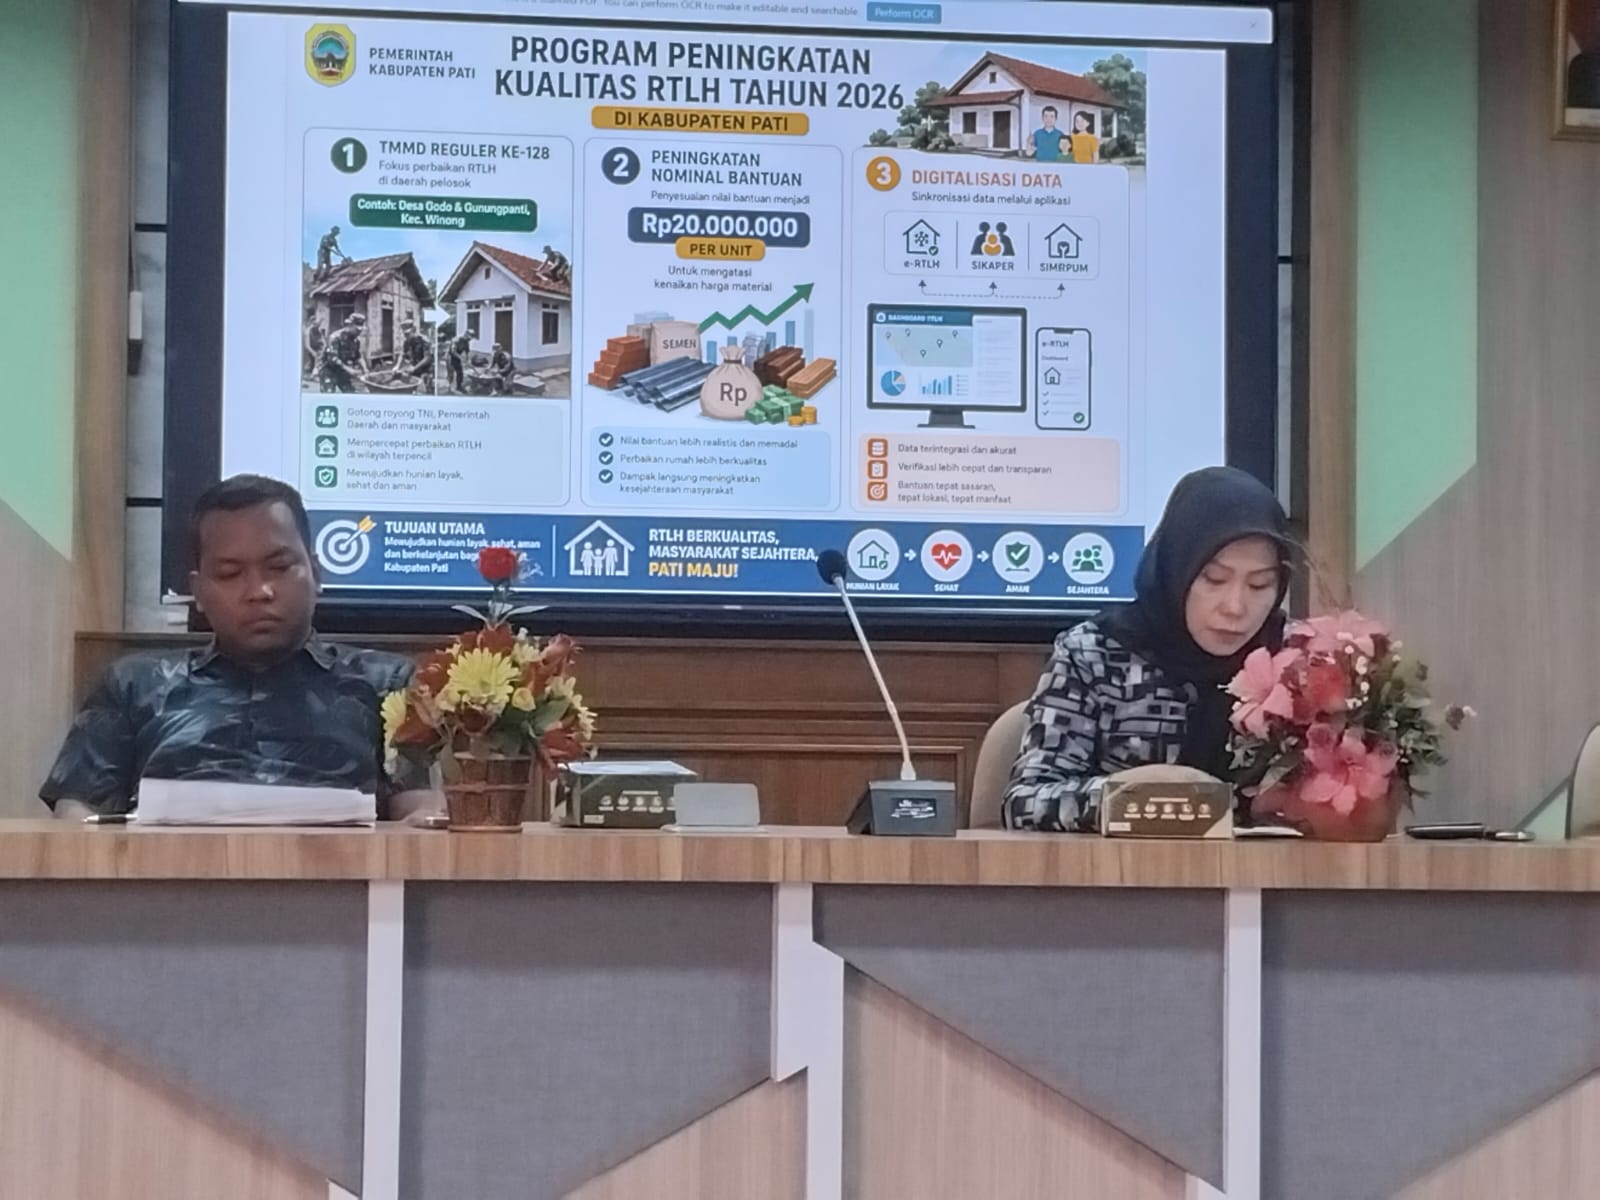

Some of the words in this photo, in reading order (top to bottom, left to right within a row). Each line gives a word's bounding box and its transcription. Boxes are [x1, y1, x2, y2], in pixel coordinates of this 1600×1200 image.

[641, 0, 679, 10] perform
[681, 1, 703, 10] OCR
[705, 2, 715, 10] to
[717, 4, 742, 12] make
[752, 5, 789, 14] editable
[791, 5, 808, 14] and
[810, 6, 858, 16] searchable
[874, 7, 911, 18] Perform
[913, 9, 935, 19] OCR
[369, 47, 454, 62] PEMERINTAH
[511, 35, 658, 68] PROGRAM
[667, 42, 871, 75] PENINGKATAN
[369, 64, 445, 78] KABUPATEN
[448, 67, 476, 79] PATI
[495, 69, 637, 101] KUALITAS
[646, 75, 720, 104] RTLH
[730, 78, 827, 108] TAHUN
[836, 81, 904, 110] 2026
[614, 110, 632, 127] DI
[638, 112, 745, 130] KABUPATEN
[751, 116, 788, 132] PATI
[341, 143, 355, 168] 1
[379, 140, 427, 156] TMMD
[431, 142, 497, 158] REGULER
[501, 145, 550, 160] KE-128
[612, 152, 630, 178] 2
[651, 150, 760, 167] PENINGKATAN
[379, 160, 410, 172] Fokus
[412, 161, 465, 175] perbaikan
[468, 163, 496, 174] RTLH
[875, 161, 892, 185] 3
[379, 175, 388, 187] di
[391, 176, 428, 188] daerah
[430, 177, 472, 189] pelosok
[651, 168, 724, 185] NOMINAL
[729, 171, 802, 187] BANTUAN
[912, 169, 1016, 187] DIGITALISASI
[1022, 172, 1063, 189] DATA
[650, 190, 709, 203] Penyesuaian
[711, 191, 731, 202] nilai
[733, 193, 771, 204] bantuan
[773, 194, 810, 206] menjadi
[912, 191, 971, 203] Sinkronisasi
[973, 193, 995, 204] data
[997, 194, 1032, 205] melalui
[1034, 195, 1071, 207] aplikasi
[357, 198, 397, 211] Contoh:
[399, 200, 424, 212] Desa
[426, 201, 452, 213] Godo
[454, 202, 462, 213] &
[464, 202, 531, 217] Gunungpanti,
[401, 213, 423, 225] Kec.
[425, 214, 465, 228] Winong
[642, 213, 798, 239] Rp20.000.000
[690, 243, 716, 257] PER
[720, 244, 753, 257] UNIT
[904, 259, 940, 269] e-RTLH
[971, 260, 1014, 271] SIKAPER
[668, 265, 698, 277] Untuk
[700, 266, 752, 279] mengatasi
[654, 279, 698, 290] kenaikan
[700, 281, 729, 293] harga
[731, 281, 772, 292] material
[662, 338, 697, 349] SEMEN
[719, 382, 748, 406] Rp
[347, 408, 382, 419] Gotong
[383, 409, 416, 421] royong
[418, 409, 436, 420] TNI,
[438, 410, 490, 421] Pemerintah
[347, 420, 379, 430] Daerah
[381, 420, 398, 431] dan
[400, 421, 451, 433] masyarakat
[347, 438, 410, 450] Mempercepat
[411, 440, 456, 450] perbaikan
[457, 440, 482, 449] RTLH
[620, 435, 640, 446] Nilai
[640, 436, 678, 446] bantuan
[679, 437, 702, 447] lebih
[703, 437, 737, 448] realistis
[739, 438, 756, 448] dan
[757, 439, 798, 449] memadai
[356, 450, 391, 462] wilayah
[392, 451, 432, 462] terpencil
[898, 443, 919, 454] Data
[920, 444, 969, 456] terintegrasi
[971, 445, 988, 455] dan
[989, 445, 1017, 455] akurat
[620, 454, 664, 464] Perbaikan
[665, 455, 695, 465] rumah
[696, 455, 717, 465] lebih
[719, 456, 767, 466] berkualitas
[346, 468, 404, 479] Mewujudkan
[405, 469, 436, 479] hunian
[437, 470, 464, 481] layak,
[898, 462, 937, 473] Verifikasi
[938, 462, 960, 473] lebih
[961, 464, 986, 475] cepat
[987, 464, 1005, 474] dan
[1006, 465, 1052, 475] transparan
[620, 471, 656, 483] Dampak
[657, 472, 698, 484] langsung
[699, 473, 761, 485] meningkatkan
[372, 481, 390, 490] dan
[392, 482, 417, 491] aman
[620, 484, 681, 495] kesejahteraan
[683, 485, 734, 496] masyarakat
[898, 481, 934, 491] Bantuan
[936, 482, 959, 493] tepat
[961, 482, 996, 493] sasaran,
[897, 493, 920, 504] tepat
[922, 493, 949, 504] lokasi,
[951, 494, 974, 505] tepat
[976, 494, 1011, 504] manfaat
[384, 520, 437, 535] TUJUAN
[439, 521, 485, 535] UTAMA
[385, 537, 437, 548] Mewujudkan
[438, 538, 466, 547] hunian
[517, 540, 541, 549] aman
[649, 528, 684, 542] RTLH
[686, 529, 780, 545] BERKUALITAS,
[384, 549, 401, 559] dan
[402, 549, 459, 561] berkelanjutan
[649, 545, 737, 560] MASYARAKAT
[741, 547, 819, 562] SEJAHTERA,
[384, 562, 430, 574] Kabupaten
[431, 563, 449, 573] Pati
[648, 562, 683, 577] PATI
[687, 563, 738, 578] MAJU!
